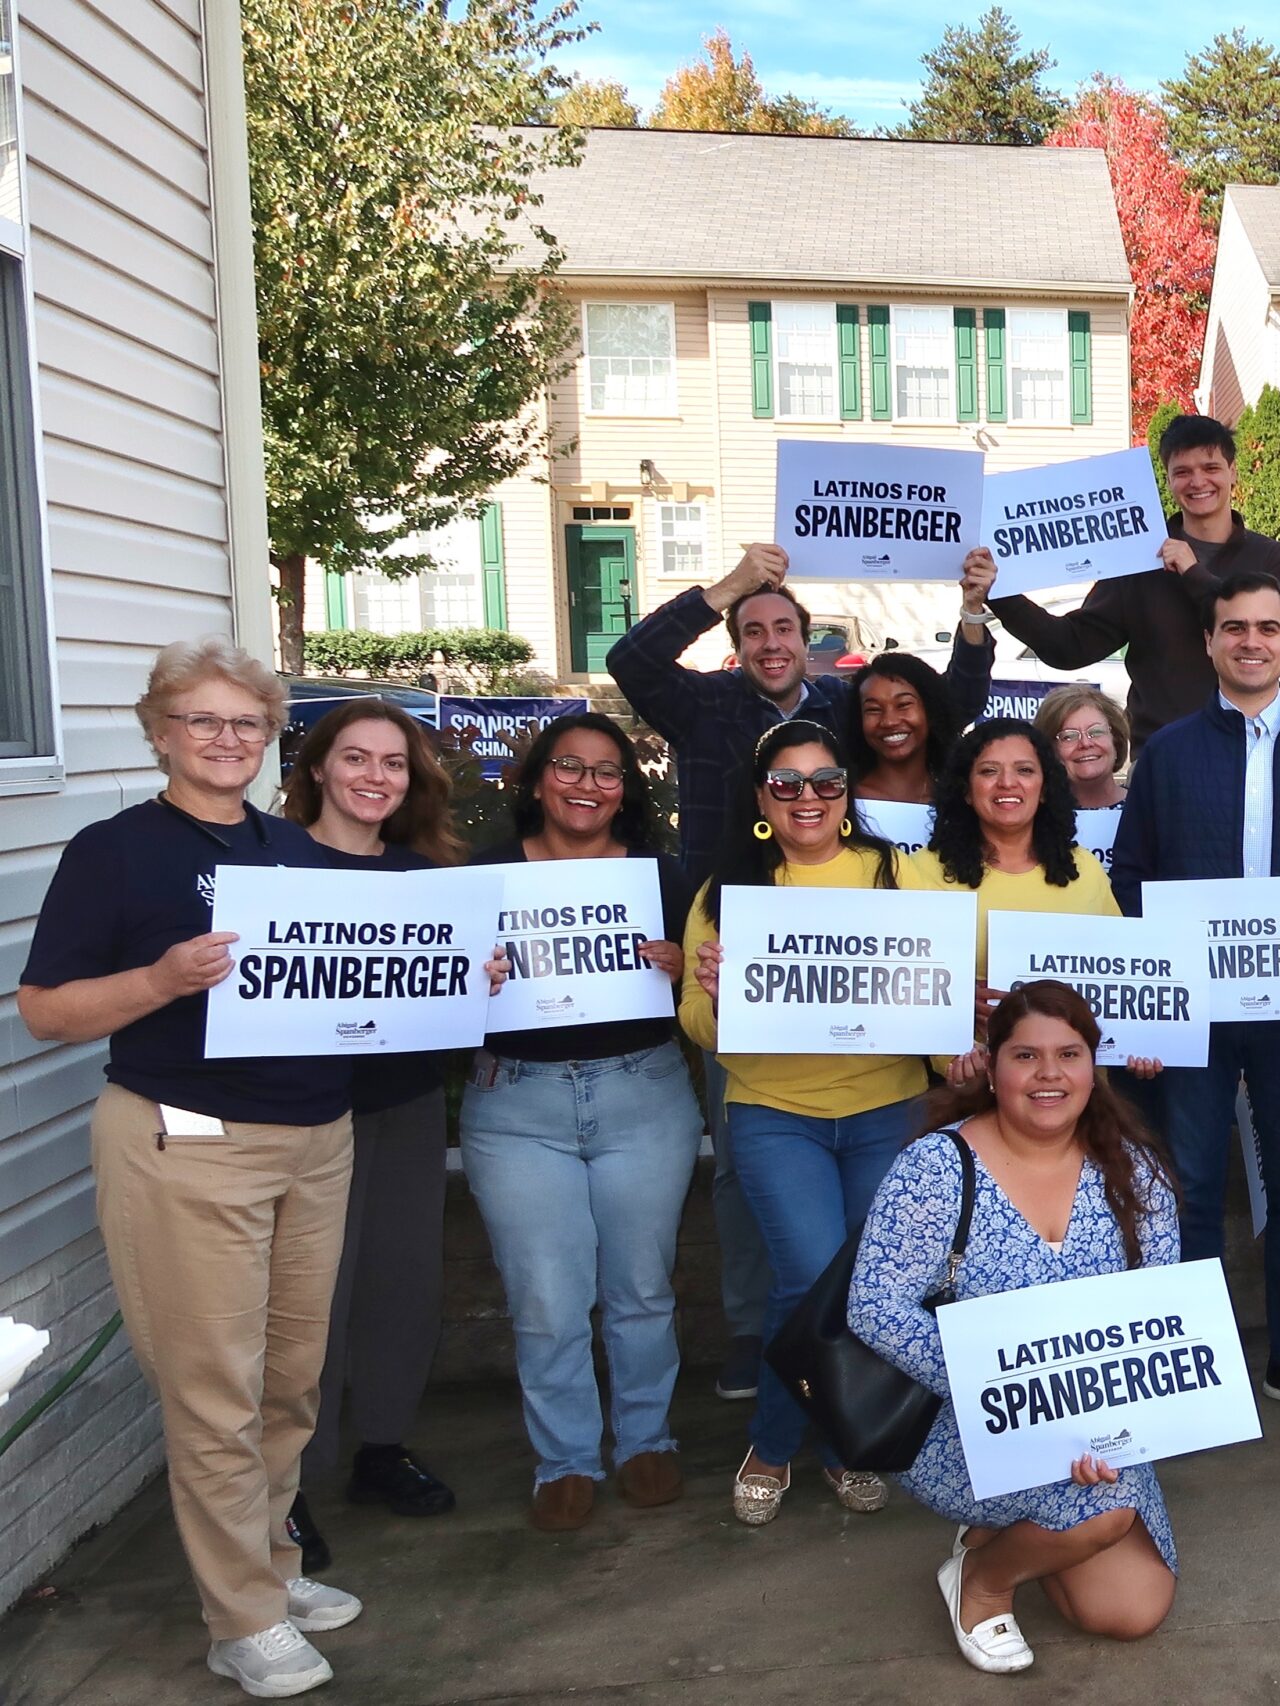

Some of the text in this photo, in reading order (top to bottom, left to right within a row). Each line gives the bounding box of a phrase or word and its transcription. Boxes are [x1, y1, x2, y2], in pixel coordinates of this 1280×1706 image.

[814, 480, 946, 502] LATINOS FOR
[1004, 487, 1125, 520] LATINOS FOR
[795, 504, 962, 543] SPANBERGER
[994, 506, 1149, 558] SPANBERGER
[983, 695, 1045, 719] SPANB
[268, 921, 453, 945] LATINOS FOR
[498, 904, 628, 932] TINOS FOR
[1208, 918, 1277, 937] TINOS
[505, 933, 652, 980] NBERGER
[768, 934, 932, 957] LATINOS FOR
[238, 954, 470, 999] SPANBERGER
[1030, 954, 1172, 977] LATINOS FOR
[744, 963, 952, 1006] SPANBERGER
[1010, 981, 1191, 1021] BERGER
[997, 1315, 1185, 1372] LATINOS FOR
[980, 1344, 1222, 1435] SPANBERGER
